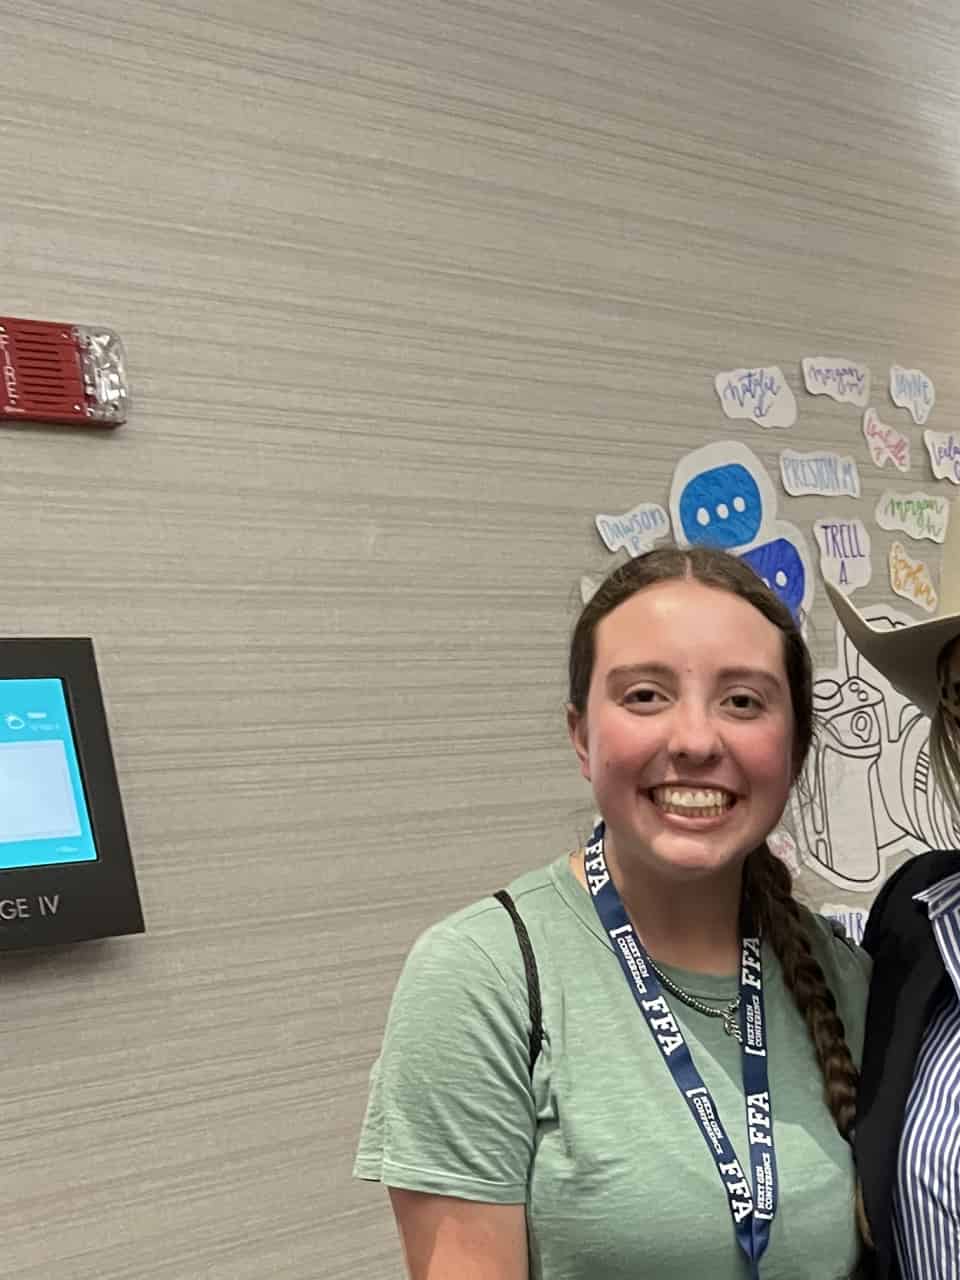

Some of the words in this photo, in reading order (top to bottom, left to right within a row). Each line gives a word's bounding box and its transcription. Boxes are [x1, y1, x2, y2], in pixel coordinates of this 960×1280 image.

[821, 523, 866, 559] TRELL
[585, 839, 610, 896] FFA
[0, 899, 30, 920] GE
[38, 894, 60, 916] IV
[742, 938, 761, 990] FFA
[642, 995, 684, 1056] FFA
[748, 1091, 772, 1147] FFA
[719, 1159, 753, 1223] FFA
